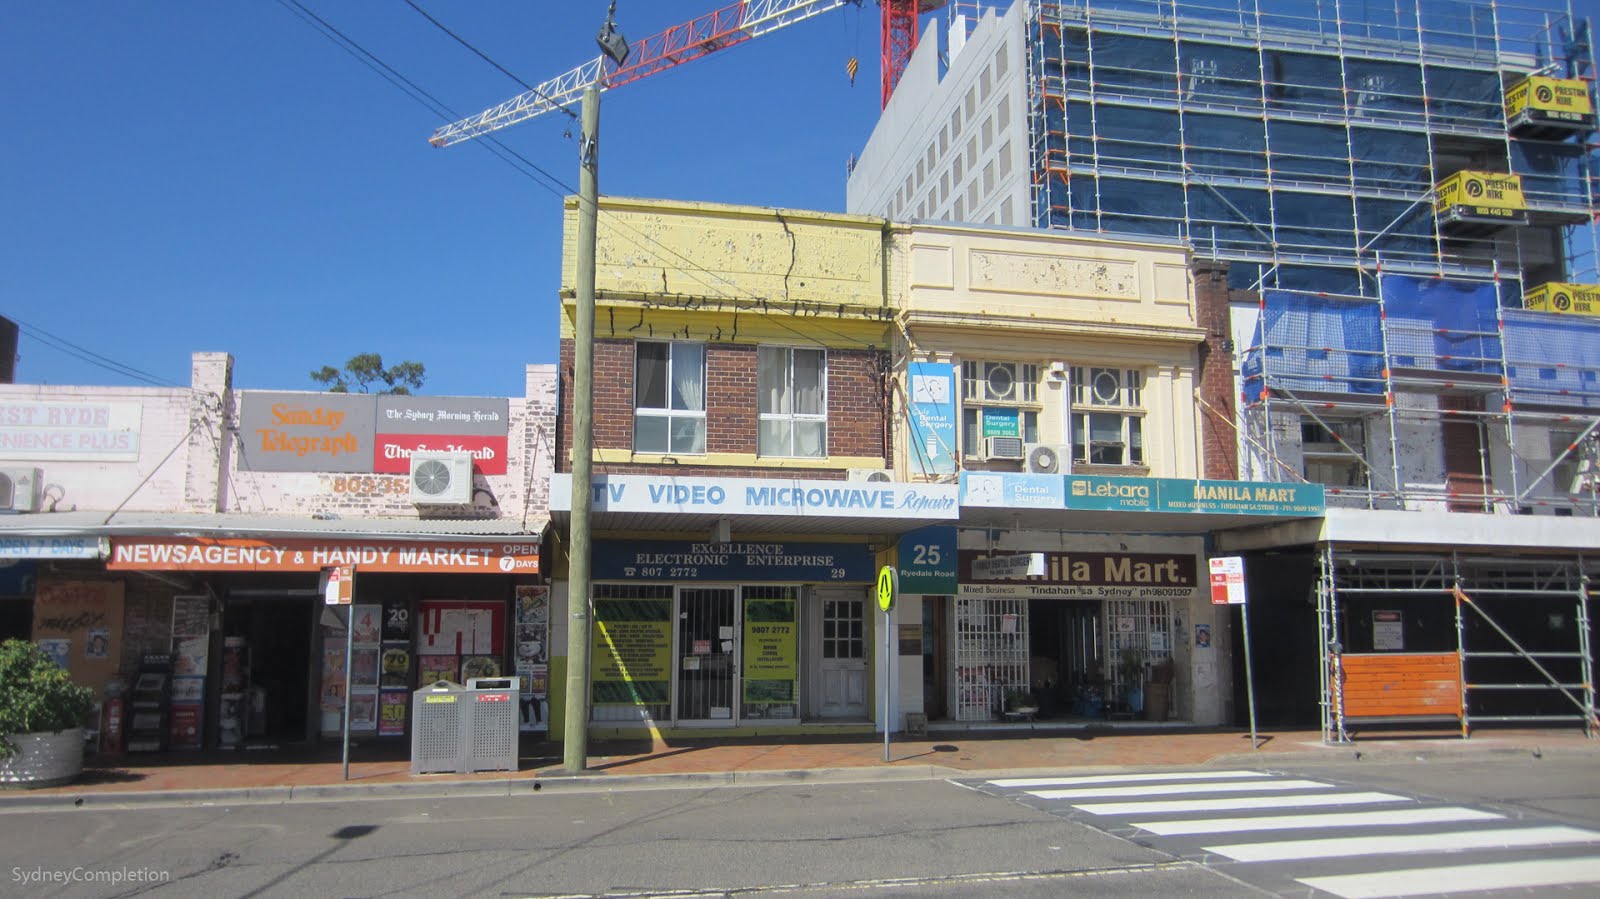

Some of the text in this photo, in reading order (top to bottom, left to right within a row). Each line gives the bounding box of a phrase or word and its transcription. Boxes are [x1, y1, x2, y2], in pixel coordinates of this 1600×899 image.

[1555, 86, 1586, 97] PRESTON
[1485, 180, 1519, 192] PRESTON
[1486, 190, 1504, 200] HIRE
[1574, 303, 1592, 313] HIRE
[48, 407, 108, 426] RYDE
[272, 403, 346, 432] Sunday
[386, 409, 500, 423] The Sydney Morning Herald
[919, 421, 953, 429] Surgery
[0, 433, 129, 450] NIENCE PLUS
[256, 428, 359, 457] Telegraph
[384, 444, 411, 459] The
[1014, 485, 1049, 494] Dental
[1087, 481, 1149, 499] Lebara
[1193, 485, 1297, 503] MANILA MART
[591, 482, 956, 513] TV VIDEO MICROWAVE Repairs
[1014, 493, 1057, 504] Surgery
[1120, 498, 1149, 507] mobile
[1168, 501, 1187, 509] MIXED
[36, 539, 45, 554] 7
[51, 539, 85, 554] DAYS
[503, 545, 539, 555] OPEN
[691, 543, 784, 555] EXCELLENCE
[116, 544, 493, 567] NEWSAGENCY & HANDY MARKET
[636, 553, 834, 567] ELECTRONIC ENTERPRISE
[913, 544, 942, 566] 25
[504, 557, 539, 571] 7 DAYS
[1104, 556, 1187, 584] Mart.
[641, 567, 846, 579] 807 2772 29
[901, 569, 956, 578] Ryedale Road
[963, 586, 984, 594] Mixed
[986, 586, 1016, 594] Business
